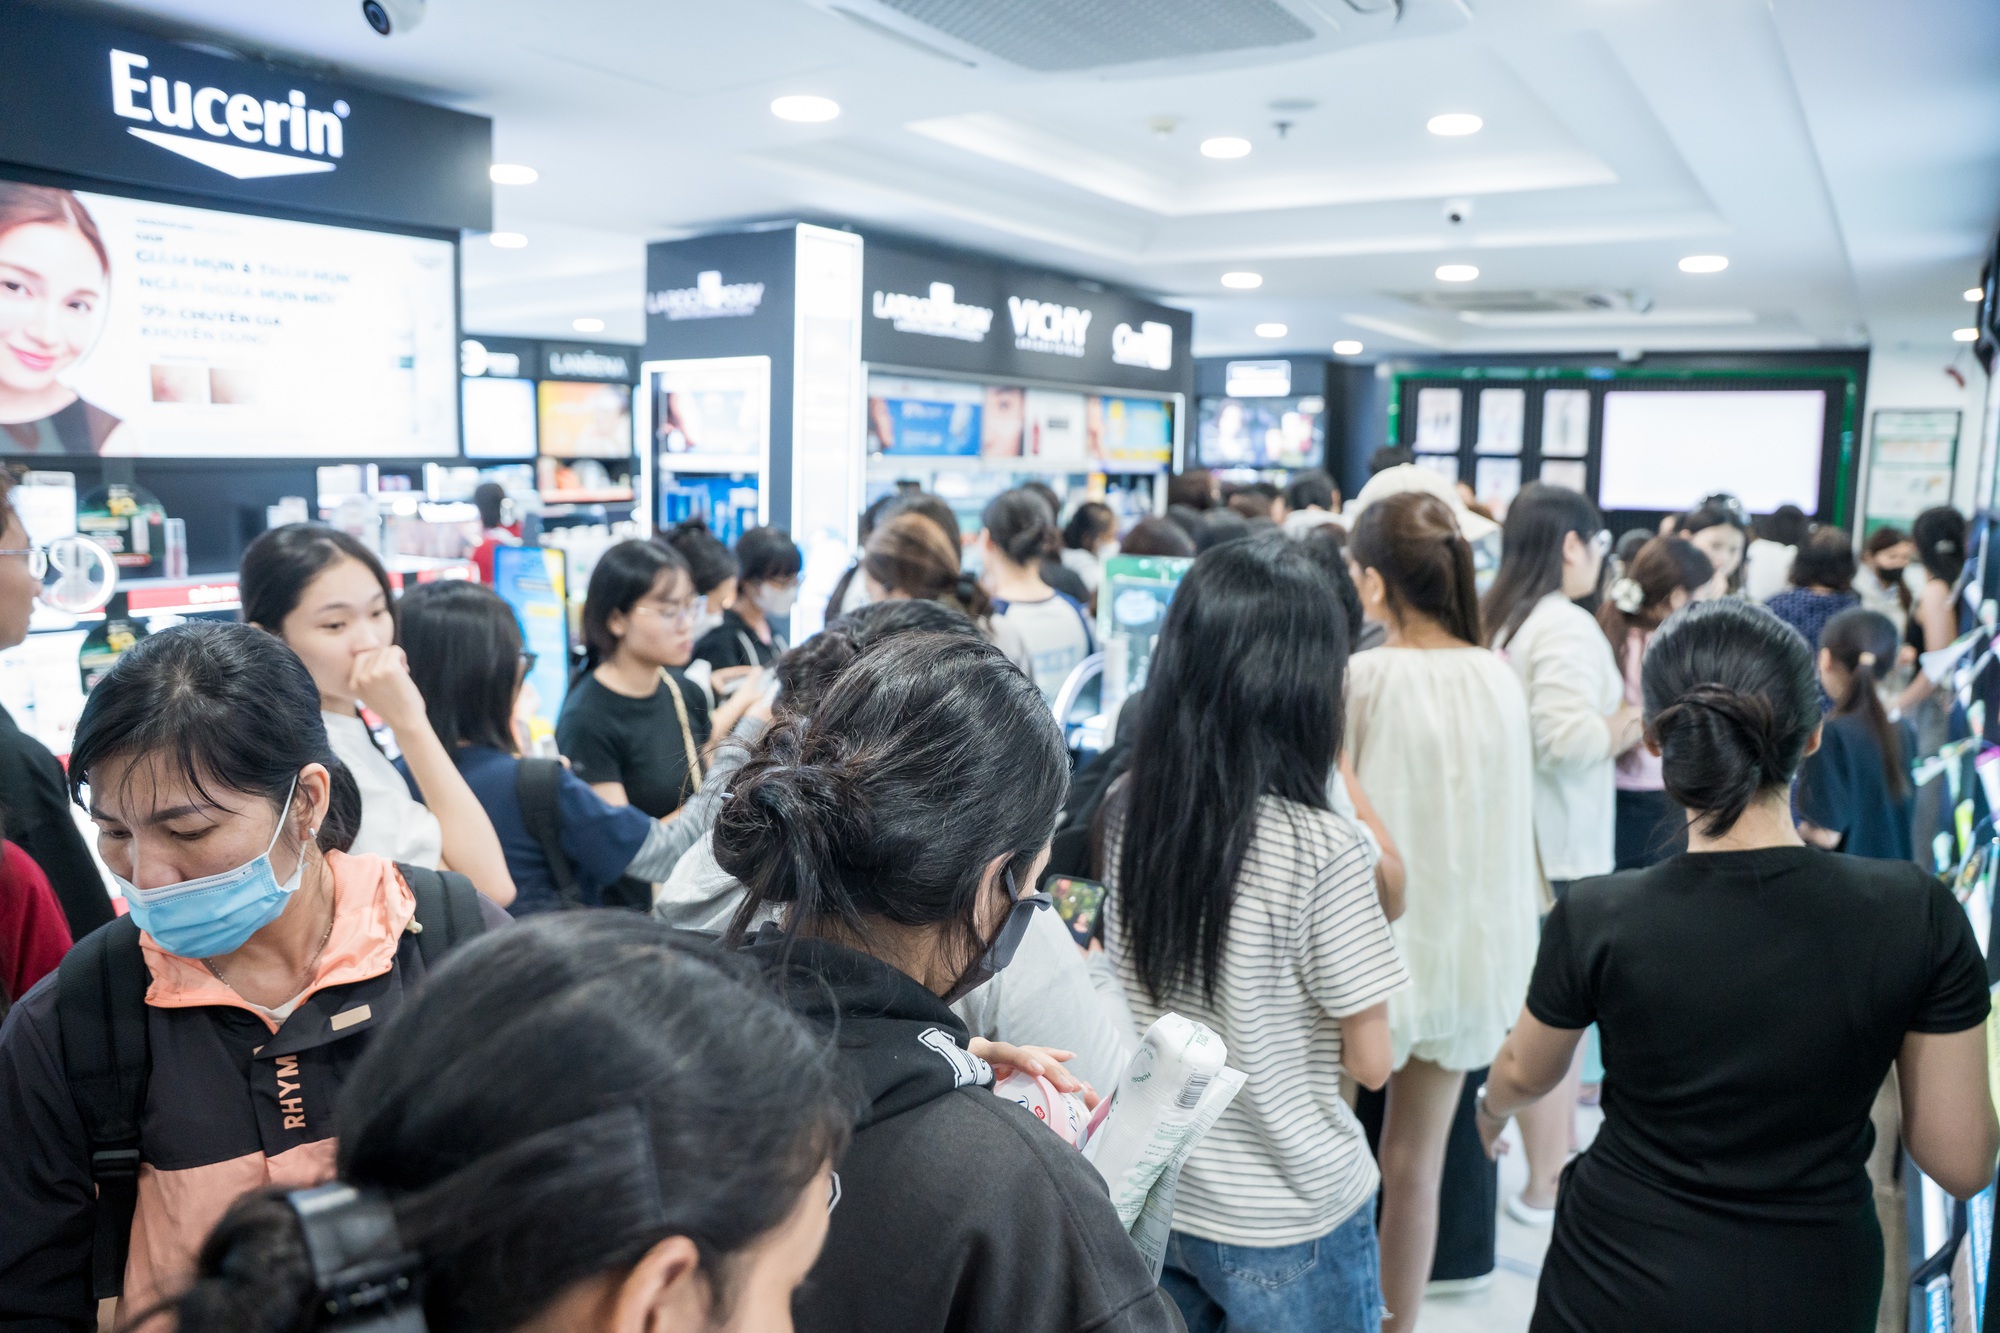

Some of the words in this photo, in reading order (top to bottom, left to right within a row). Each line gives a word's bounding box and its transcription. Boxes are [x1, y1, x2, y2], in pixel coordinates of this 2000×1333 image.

[109, 48, 345, 159] Eucerin
[1008, 296, 1093, 347] VICHY
[275, 1055, 306, 1130] RHYM
